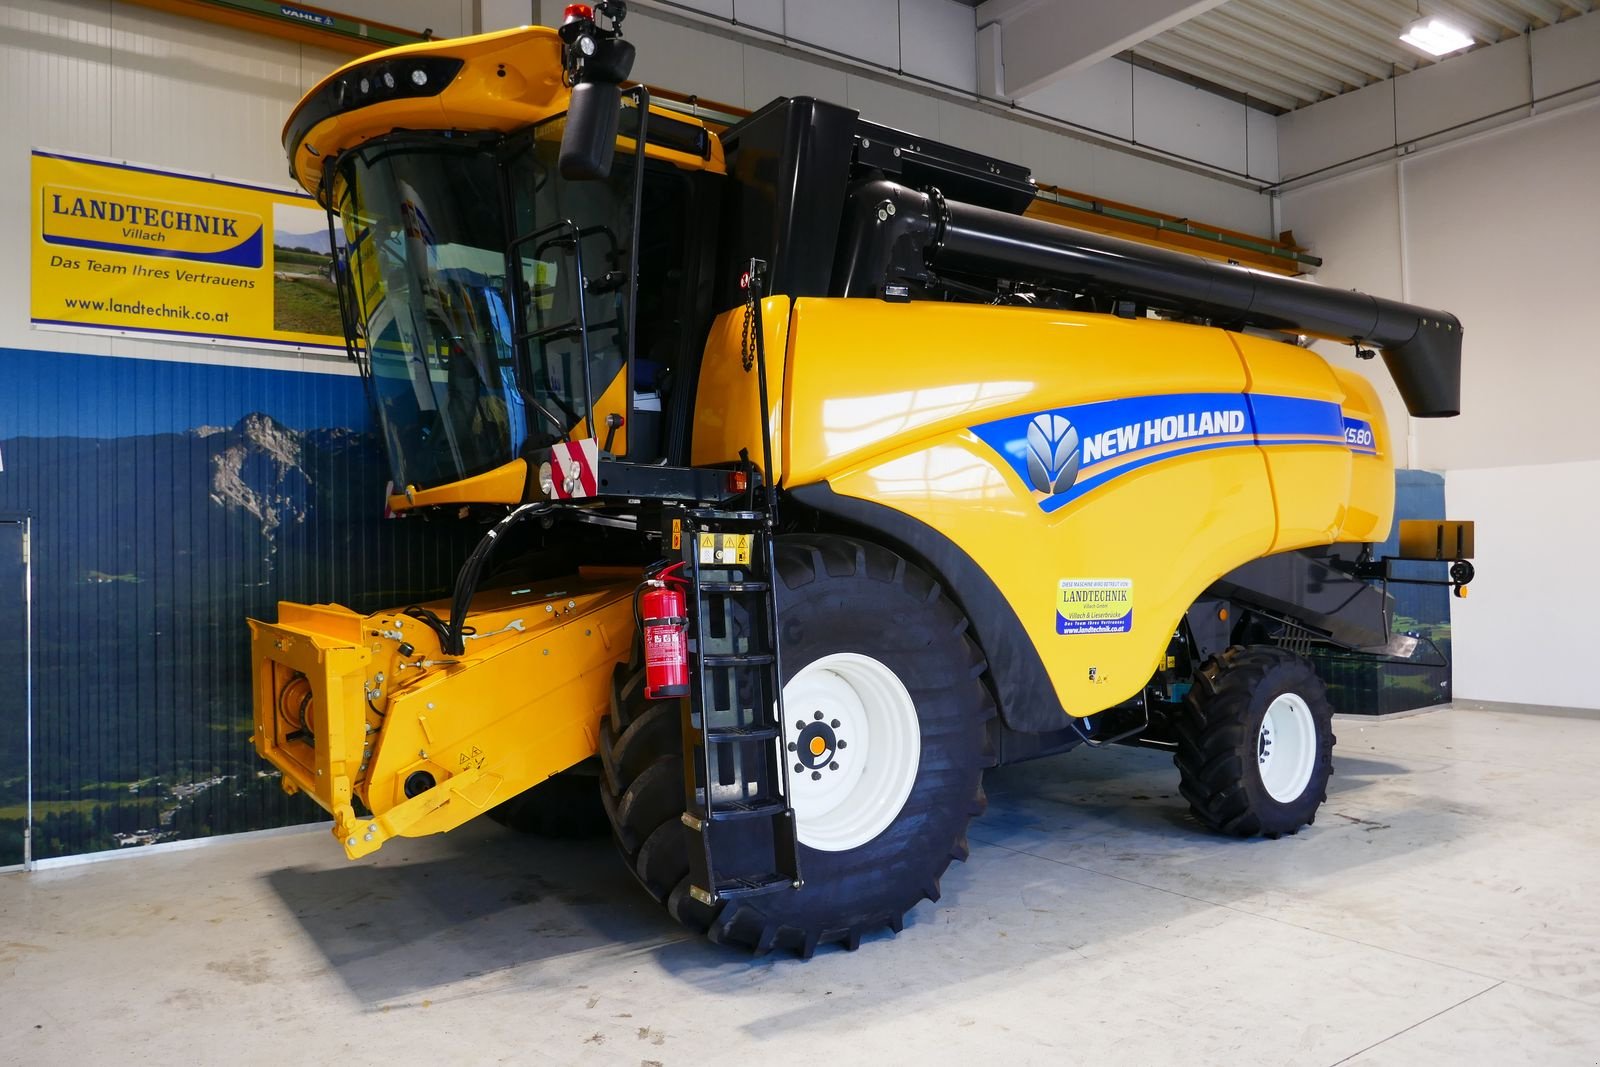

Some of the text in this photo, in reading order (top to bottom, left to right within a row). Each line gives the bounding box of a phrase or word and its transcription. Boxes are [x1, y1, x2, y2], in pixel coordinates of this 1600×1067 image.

[281, 9, 323, 23] VAHLE
[52, 194, 239, 238] LANDTECHNIK
[122, 228, 166, 242] Villach
[50, 255, 256, 290] Das Team Ihres Vertrauens
[65, 298, 230, 323] www.landtechnik.co.at
[1082, 410, 1245, 464] NEW HOLLAND
[1063, 590, 1127, 602] LANDTECHNIK
[1063, 626, 1125, 634] www.landtechnik.co.at
